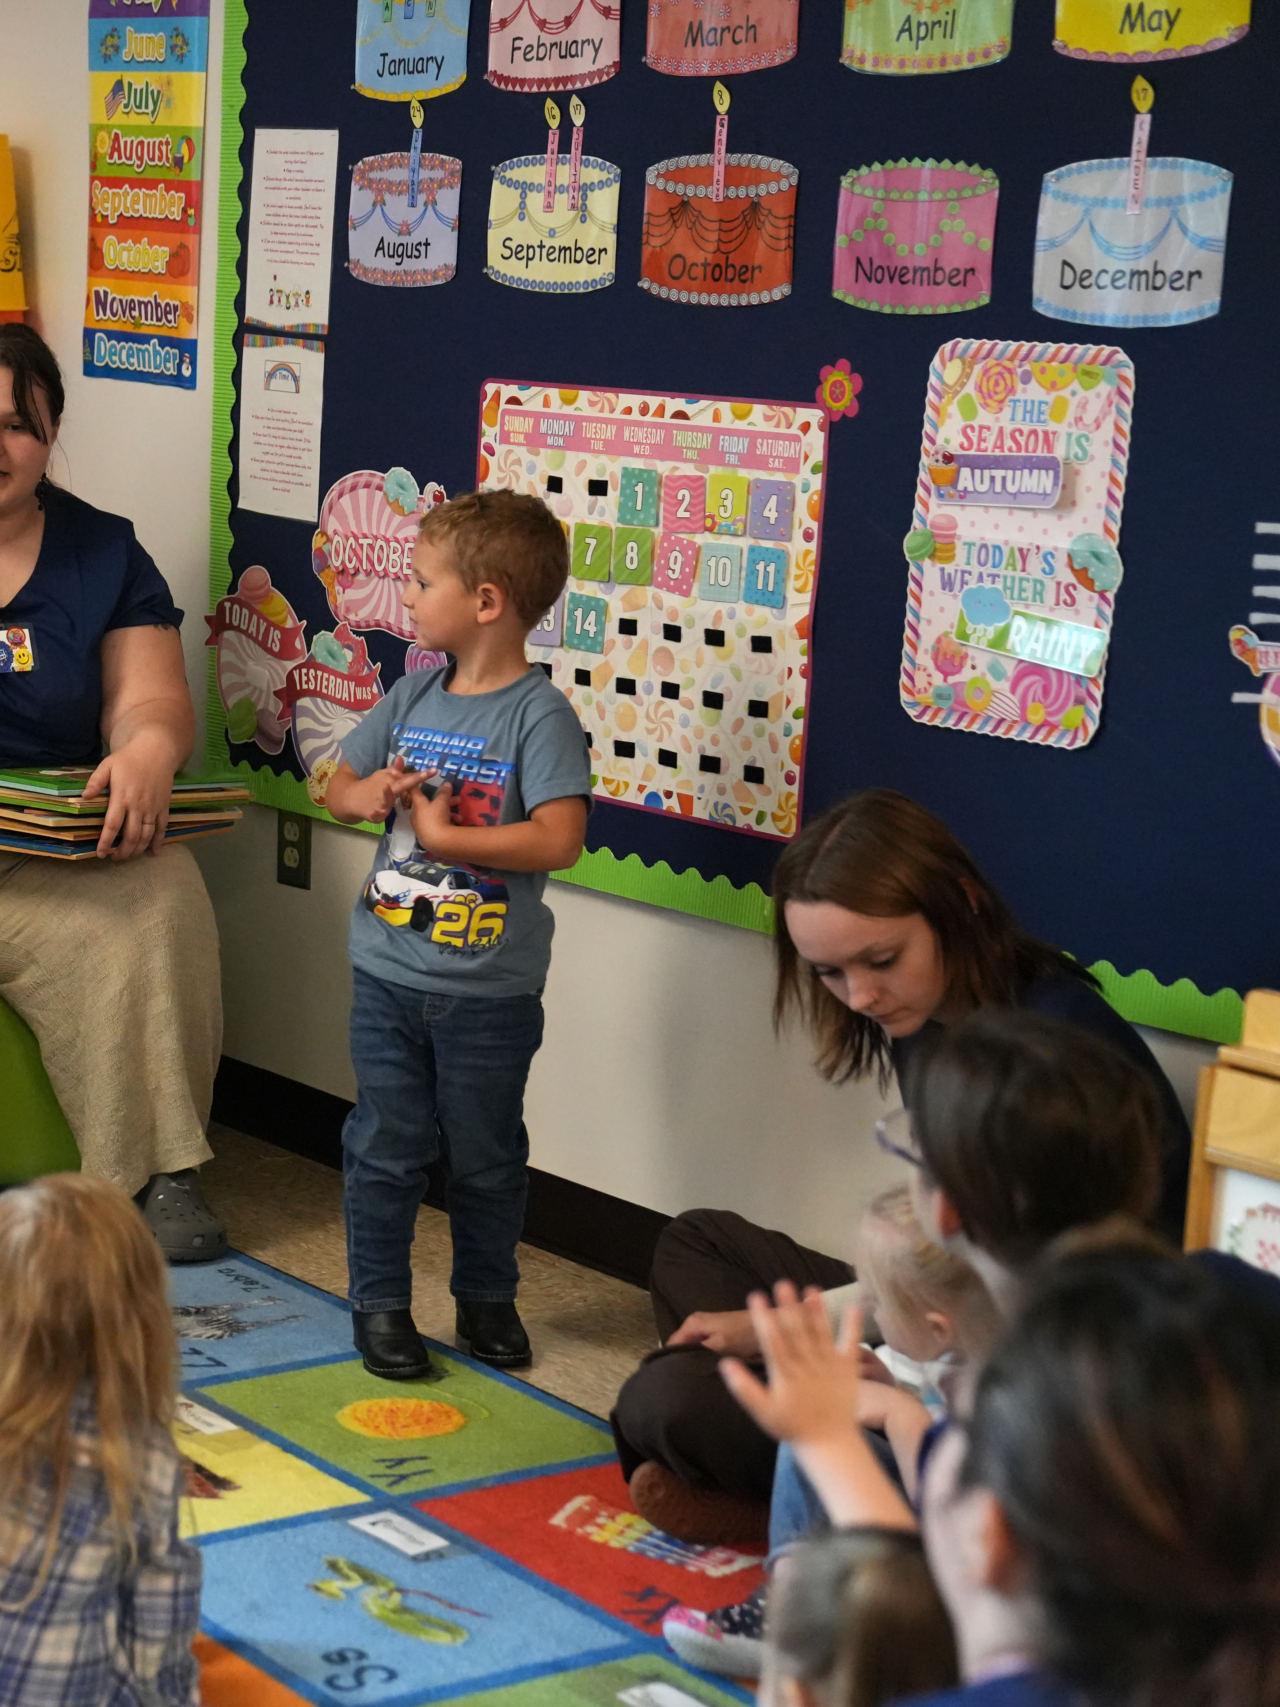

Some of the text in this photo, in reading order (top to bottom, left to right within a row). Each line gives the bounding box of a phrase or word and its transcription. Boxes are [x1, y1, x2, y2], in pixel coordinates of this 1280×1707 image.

[684, 16, 757, 48] March
[896, 9, 955, 50] April
[1119, 2, 1182, 41] May
[123, 26, 166, 62] June
[510, 36, 602, 64] February
[377, 53, 444, 81] January
[122, 80, 163, 123] July
[717, 89, 724, 105] 8
[107, 129, 172, 172] August
[92, 181, 184, 223] September
[104, 236, 169, 273] October
[375, 237, 431, 266] August
[501, 236, 608, 269] September
[668, 254, 762, 284] October
[855, 256, 975, 289] November
[1059, 259, 1203, 292] December
[93, 287, 180, 327] November
[94, 332, 179, 375] December
[1008, 398, 1049, 424] THE
[504, 415, 801, 458] SUNDAY MONDAY TUESDAY WEDNESDAY THURSDAY FRIDAY SATURDAY
[510, 432, 786, 469] SUN. MON. TUE. WED. THU. FRI. SAT.
[959, 423, 1091, 463] SEASON IS
[957, 467, 1055, 494] AUTUMN
[634, 482, 778, 524] 1 2 3 4
[584, 537, 776, 592] 7 8 9 10 11
[963, 541, 1056, 576] TODAY'S
[1054, 580, 1078, 608] IS
[224, 601, 281, 653] TODAY IS
[573, 607, 597, 638] 14
[1006, 614, 1100, 670] RAINY
[293, 667, 371, 703] YESTERDAY WAS
[398, 726, 487, 758] WANNA
[407, 750, 515, 786] GO FAST
[431, 900, 507, 948] 26
